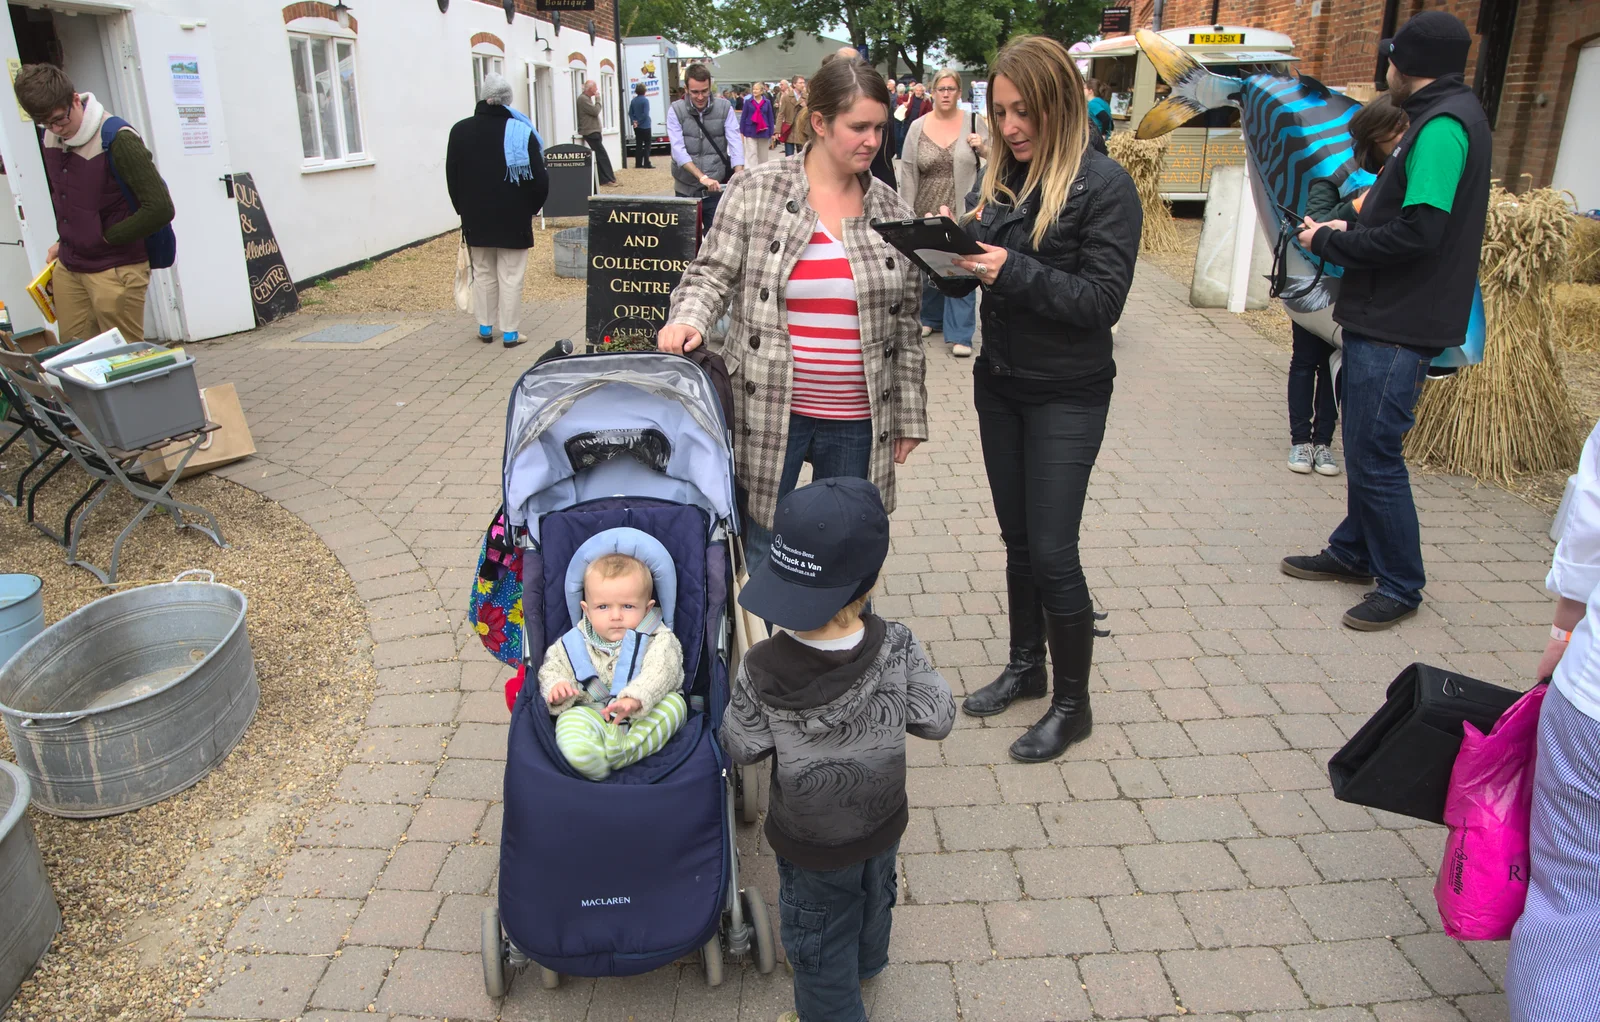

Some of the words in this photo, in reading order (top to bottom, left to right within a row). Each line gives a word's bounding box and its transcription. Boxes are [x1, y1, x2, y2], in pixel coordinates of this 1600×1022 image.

[545, 0, 587, 8] Boutique
[1200, 34, 1216, 43] YBJ
[1218, 34, 1236, 43] 351X
[546, 152, 586, 160] CARAMEL
[1168, 143, 1196, 156] EAL
[1160, 171, 1211, 183] HANDM
[234, 183, 260, 210] QUE
[240, 213, 258, 234] &
[607, 209, 679, 228] ANTIQUE
[244, 238, 278, 260] ollectors
[623, 234, 660, 249] AND
[592, 255, 690, 273] COLLECTORS
[253, 267, 287, 301] CENTRE
[610, 278, 671, 295] CENTRE
[613, 304, 667, 321] OPEN
[612, 327, 626, 337] AS
[629, 327, 658, 339] USUA
[781, 552, 800, 566] Truck
[807, 561, 822, 572] Van
[1453, 860, 1464, 895] newlife
[581, 896, 631, 907] MACLAREN
